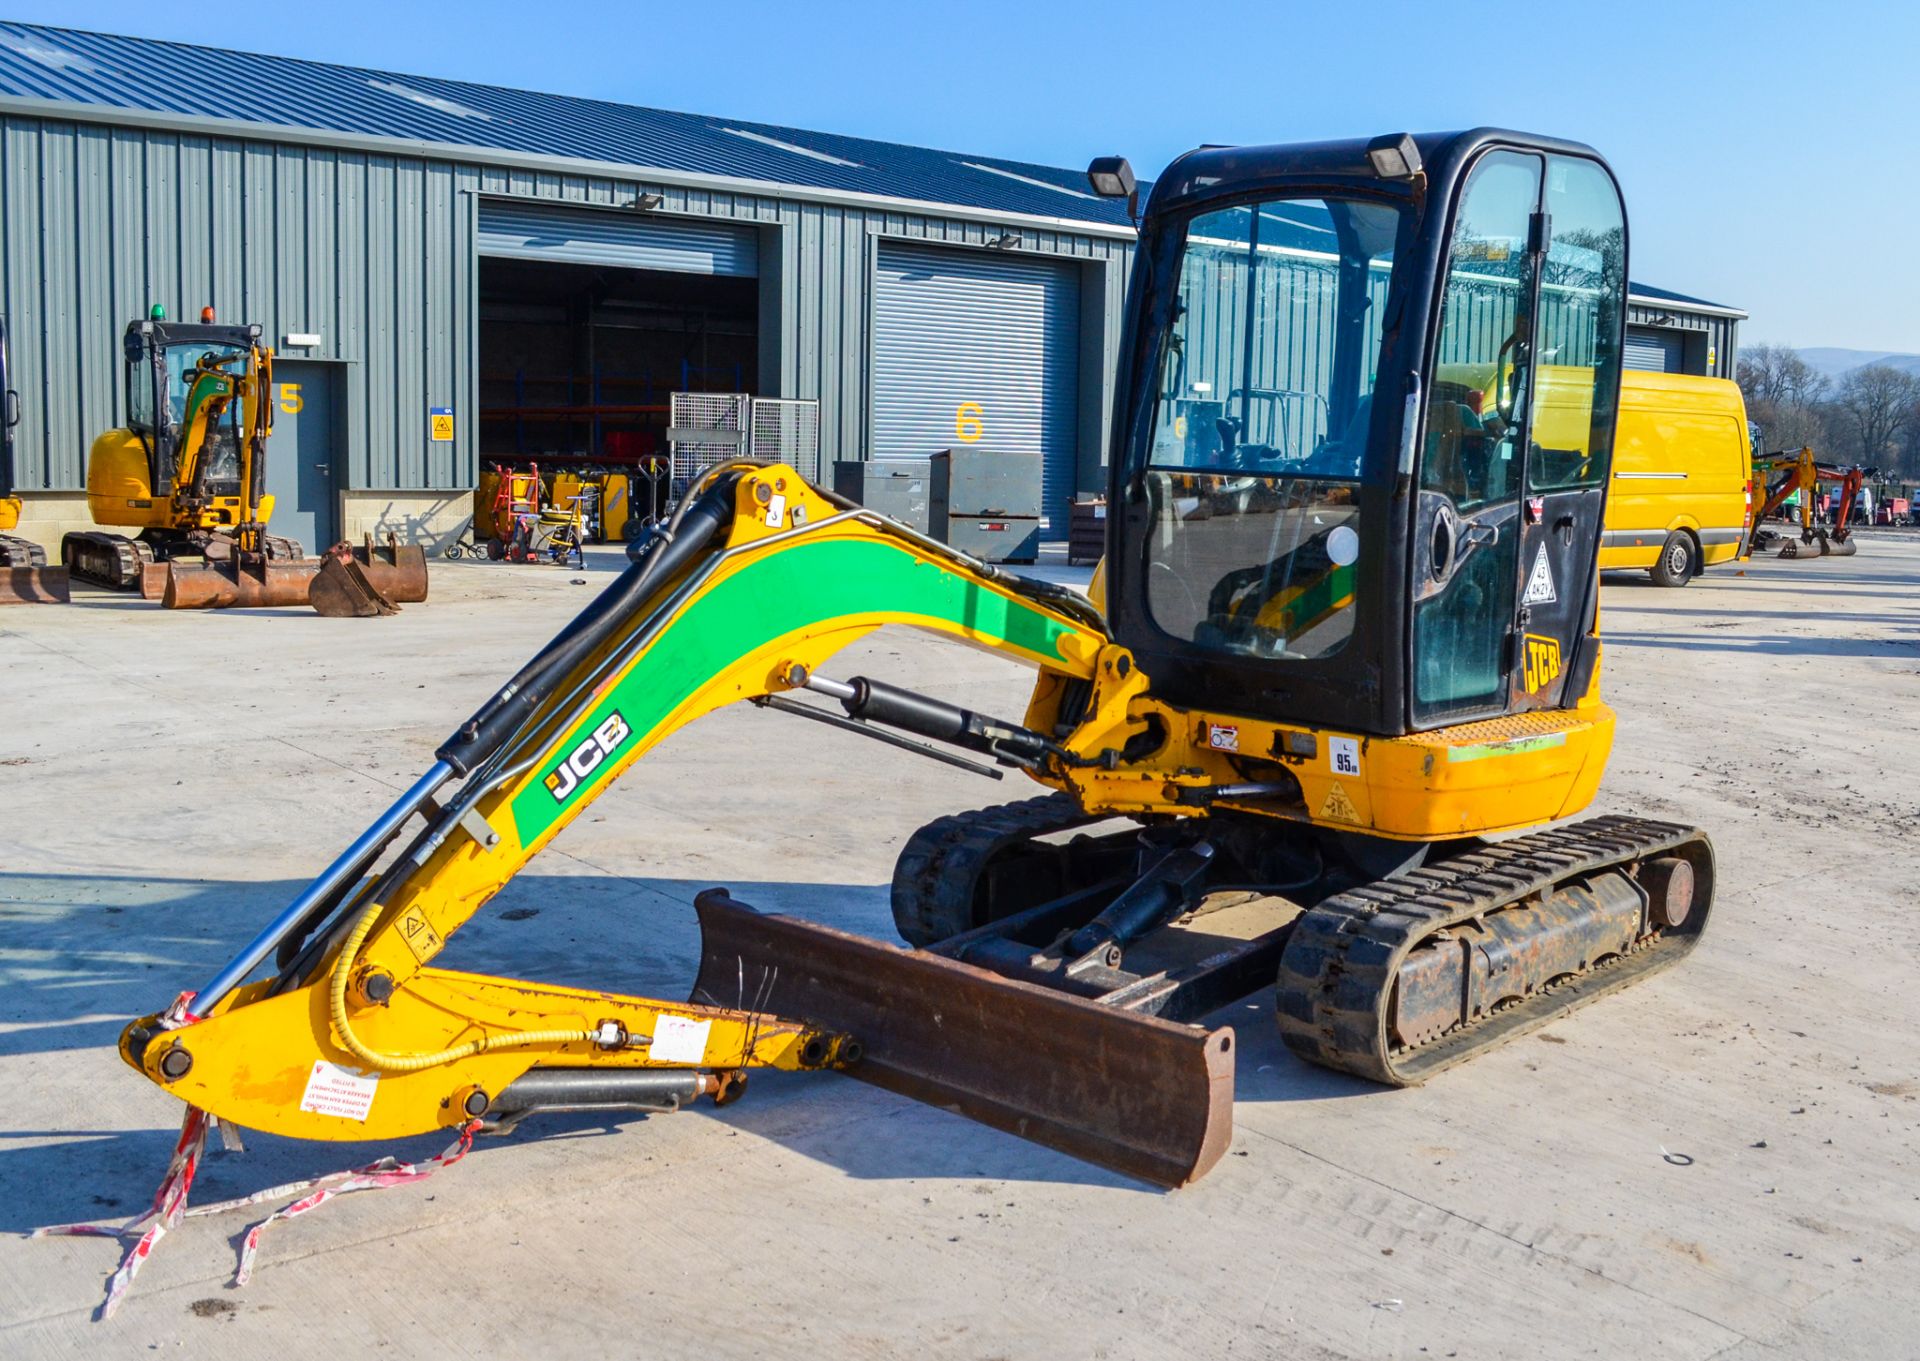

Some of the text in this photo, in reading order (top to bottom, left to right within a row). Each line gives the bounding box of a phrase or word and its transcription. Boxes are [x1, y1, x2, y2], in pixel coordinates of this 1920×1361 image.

[280, 384, 303, 414] 5
[956, 401, 984, 443] 6
[1528, 641, 1559, 694] JCB
[553, 714, 629, 800] JCB
